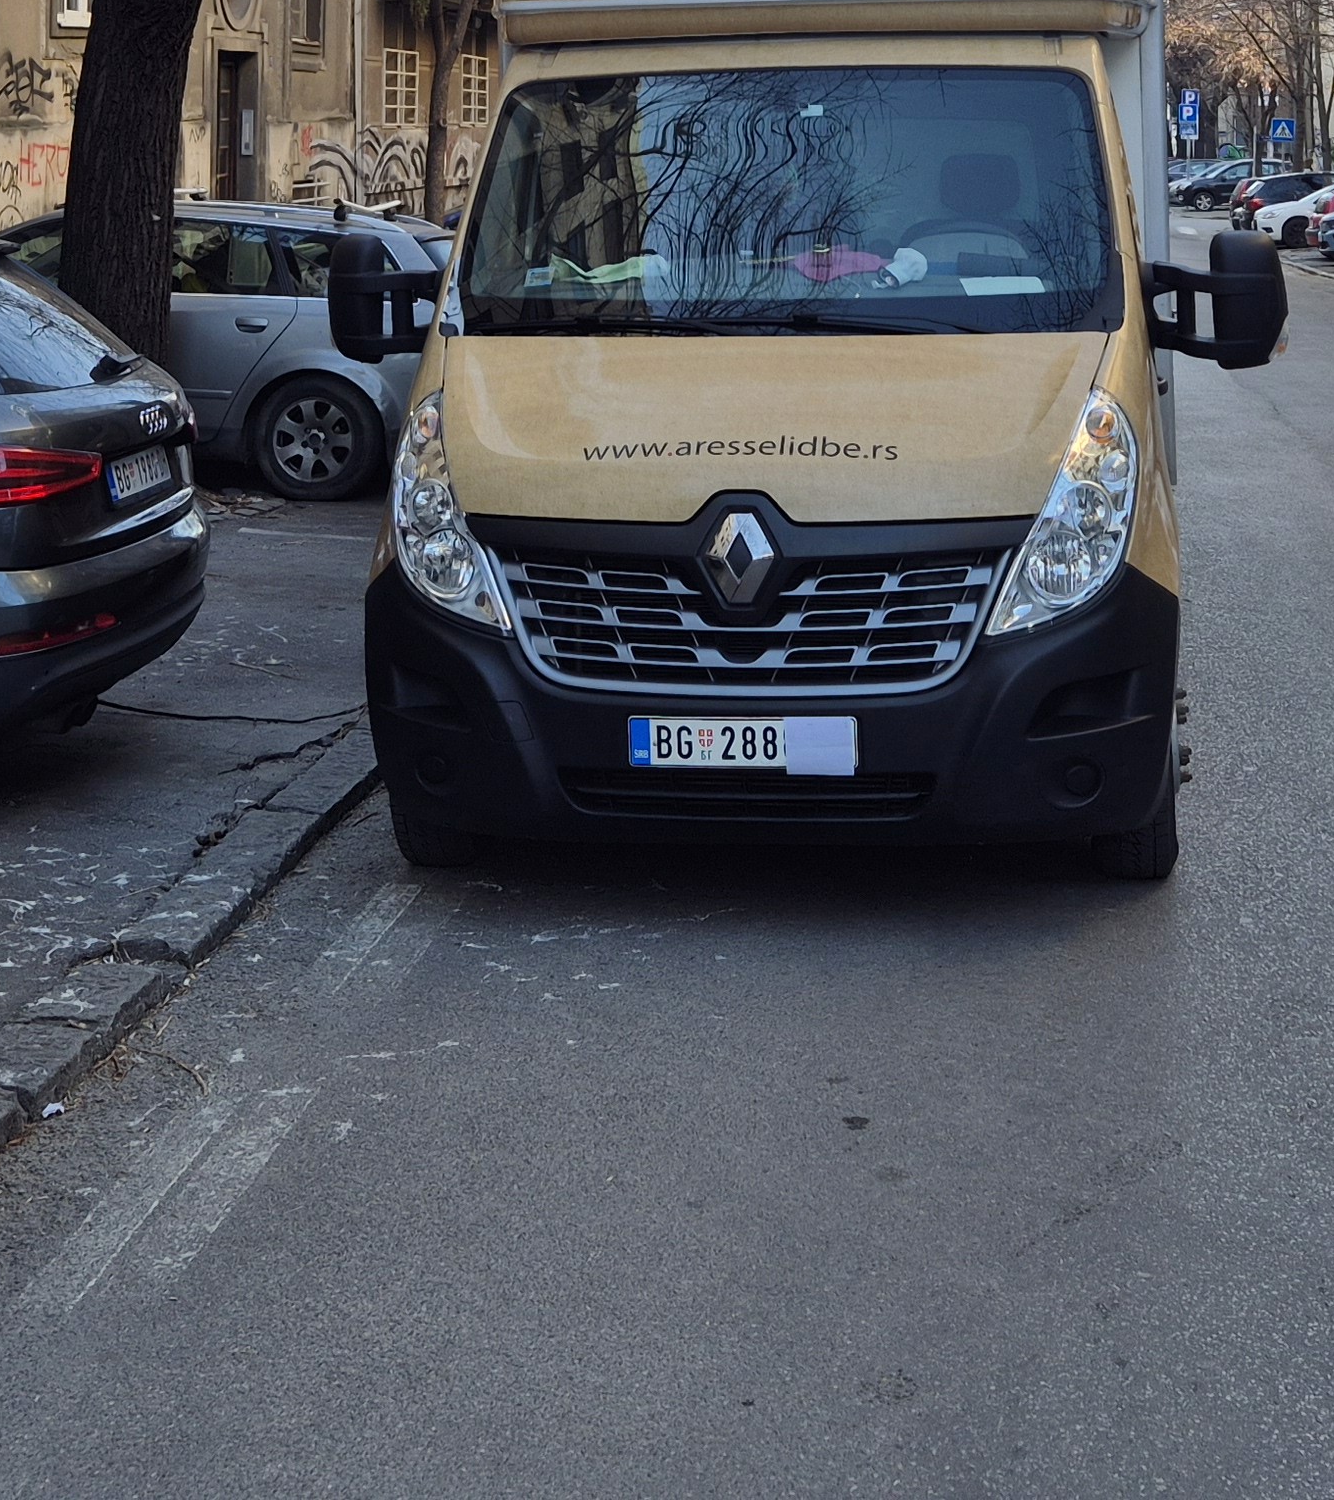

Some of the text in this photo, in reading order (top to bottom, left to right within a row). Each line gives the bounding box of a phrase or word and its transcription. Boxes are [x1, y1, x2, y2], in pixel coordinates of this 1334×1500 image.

[1185, 91, 1196, 104] P
[1182, 106, 1194, 120] P
[582, 435, 899, 461] www.aresselidbe.rs
[114, 461, 132, 494] BG
[656, 725, 787, 761] BG 288
